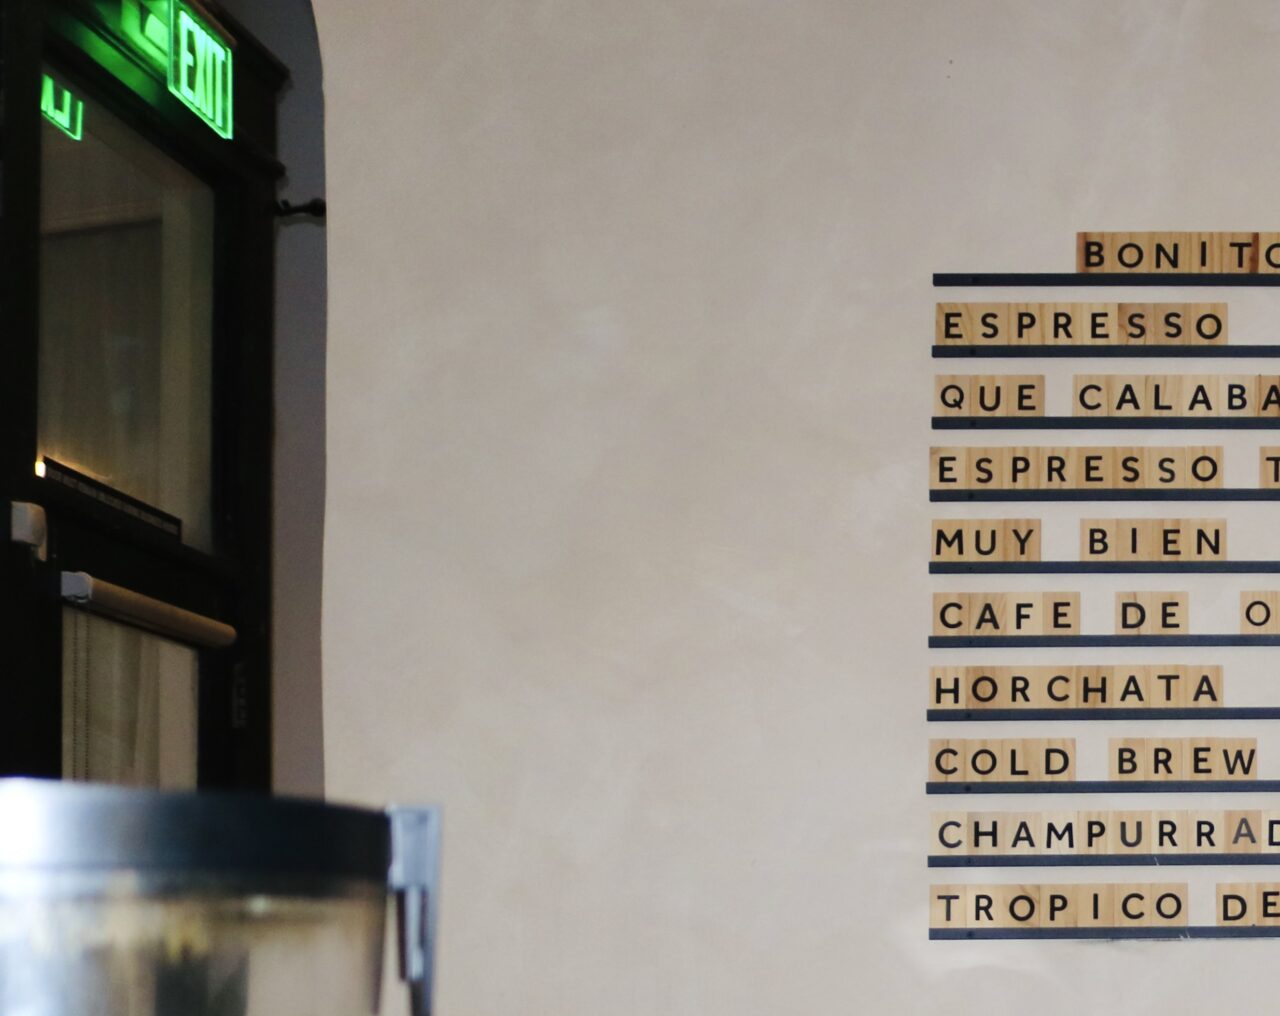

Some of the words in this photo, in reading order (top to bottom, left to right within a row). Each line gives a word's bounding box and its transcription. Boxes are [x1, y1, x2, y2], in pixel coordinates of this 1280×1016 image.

[179, 9, 227, 128] EXIT
[943, 311, 1223, 341] ESPRESSO
[940, 383, 1037, 413] QUE
[938, 455, 1218, 484] ESPRESSO
[935, 528, 1034, 556] MUY
[1089, 527, 1220, 556] BIEN
[939, 601, 1072, 630] CAFE
[1121, 601, 1180, 629] DE
[935, 674, 1218, 705] HORCHATA
[934, 747, 1070, 776] COLD
[1118, 746, 1256, 776] BREW
[937, 892, 1182, 922] TROPICO
